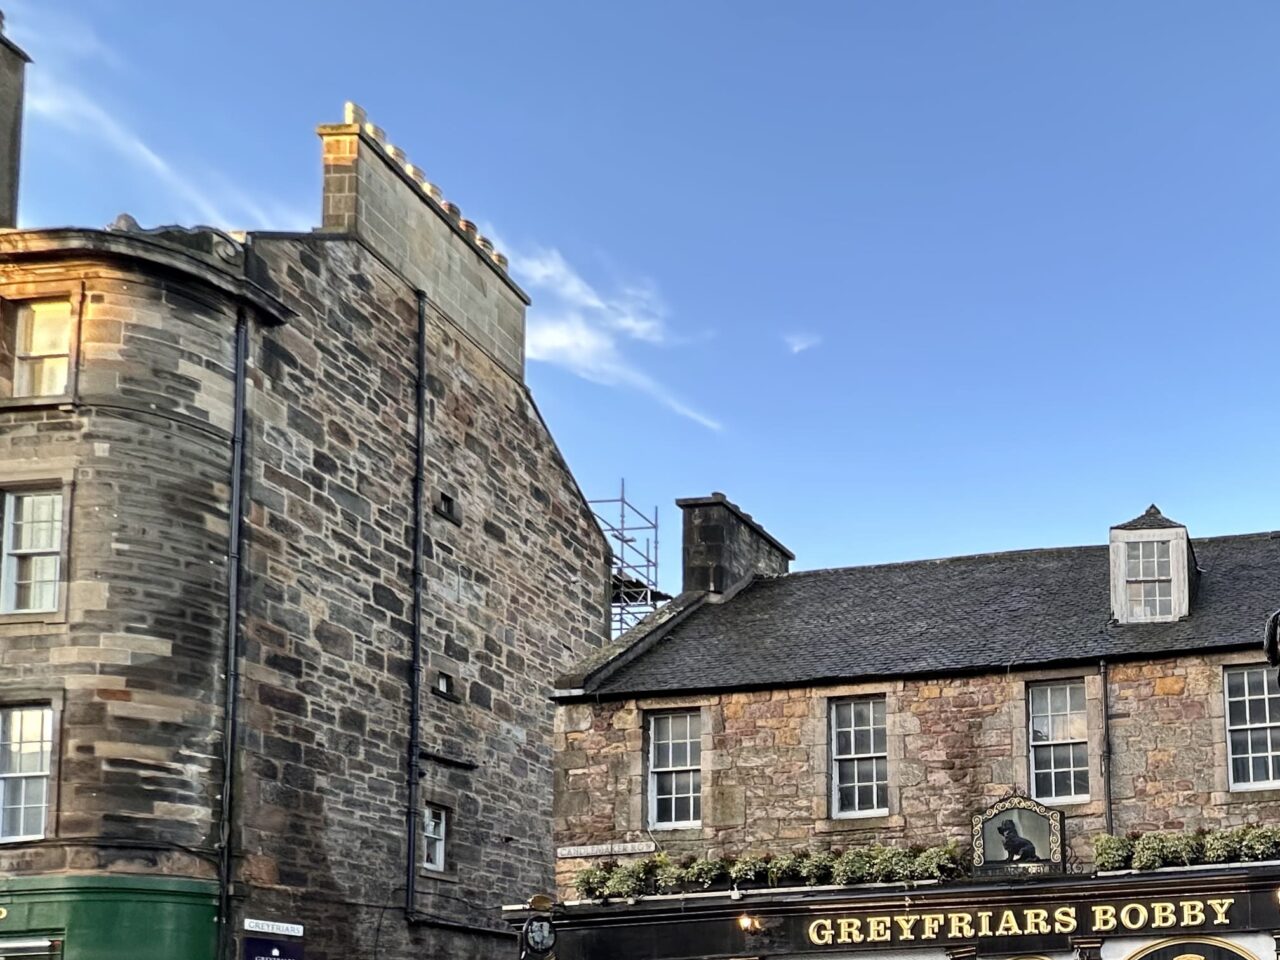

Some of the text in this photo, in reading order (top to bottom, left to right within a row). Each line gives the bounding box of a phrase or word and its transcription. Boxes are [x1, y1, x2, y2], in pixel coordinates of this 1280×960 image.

[248, 921, 301, 935] GREYFRIARS
[808, 899, 1235, 946] GREYFRIARS BOBBY
